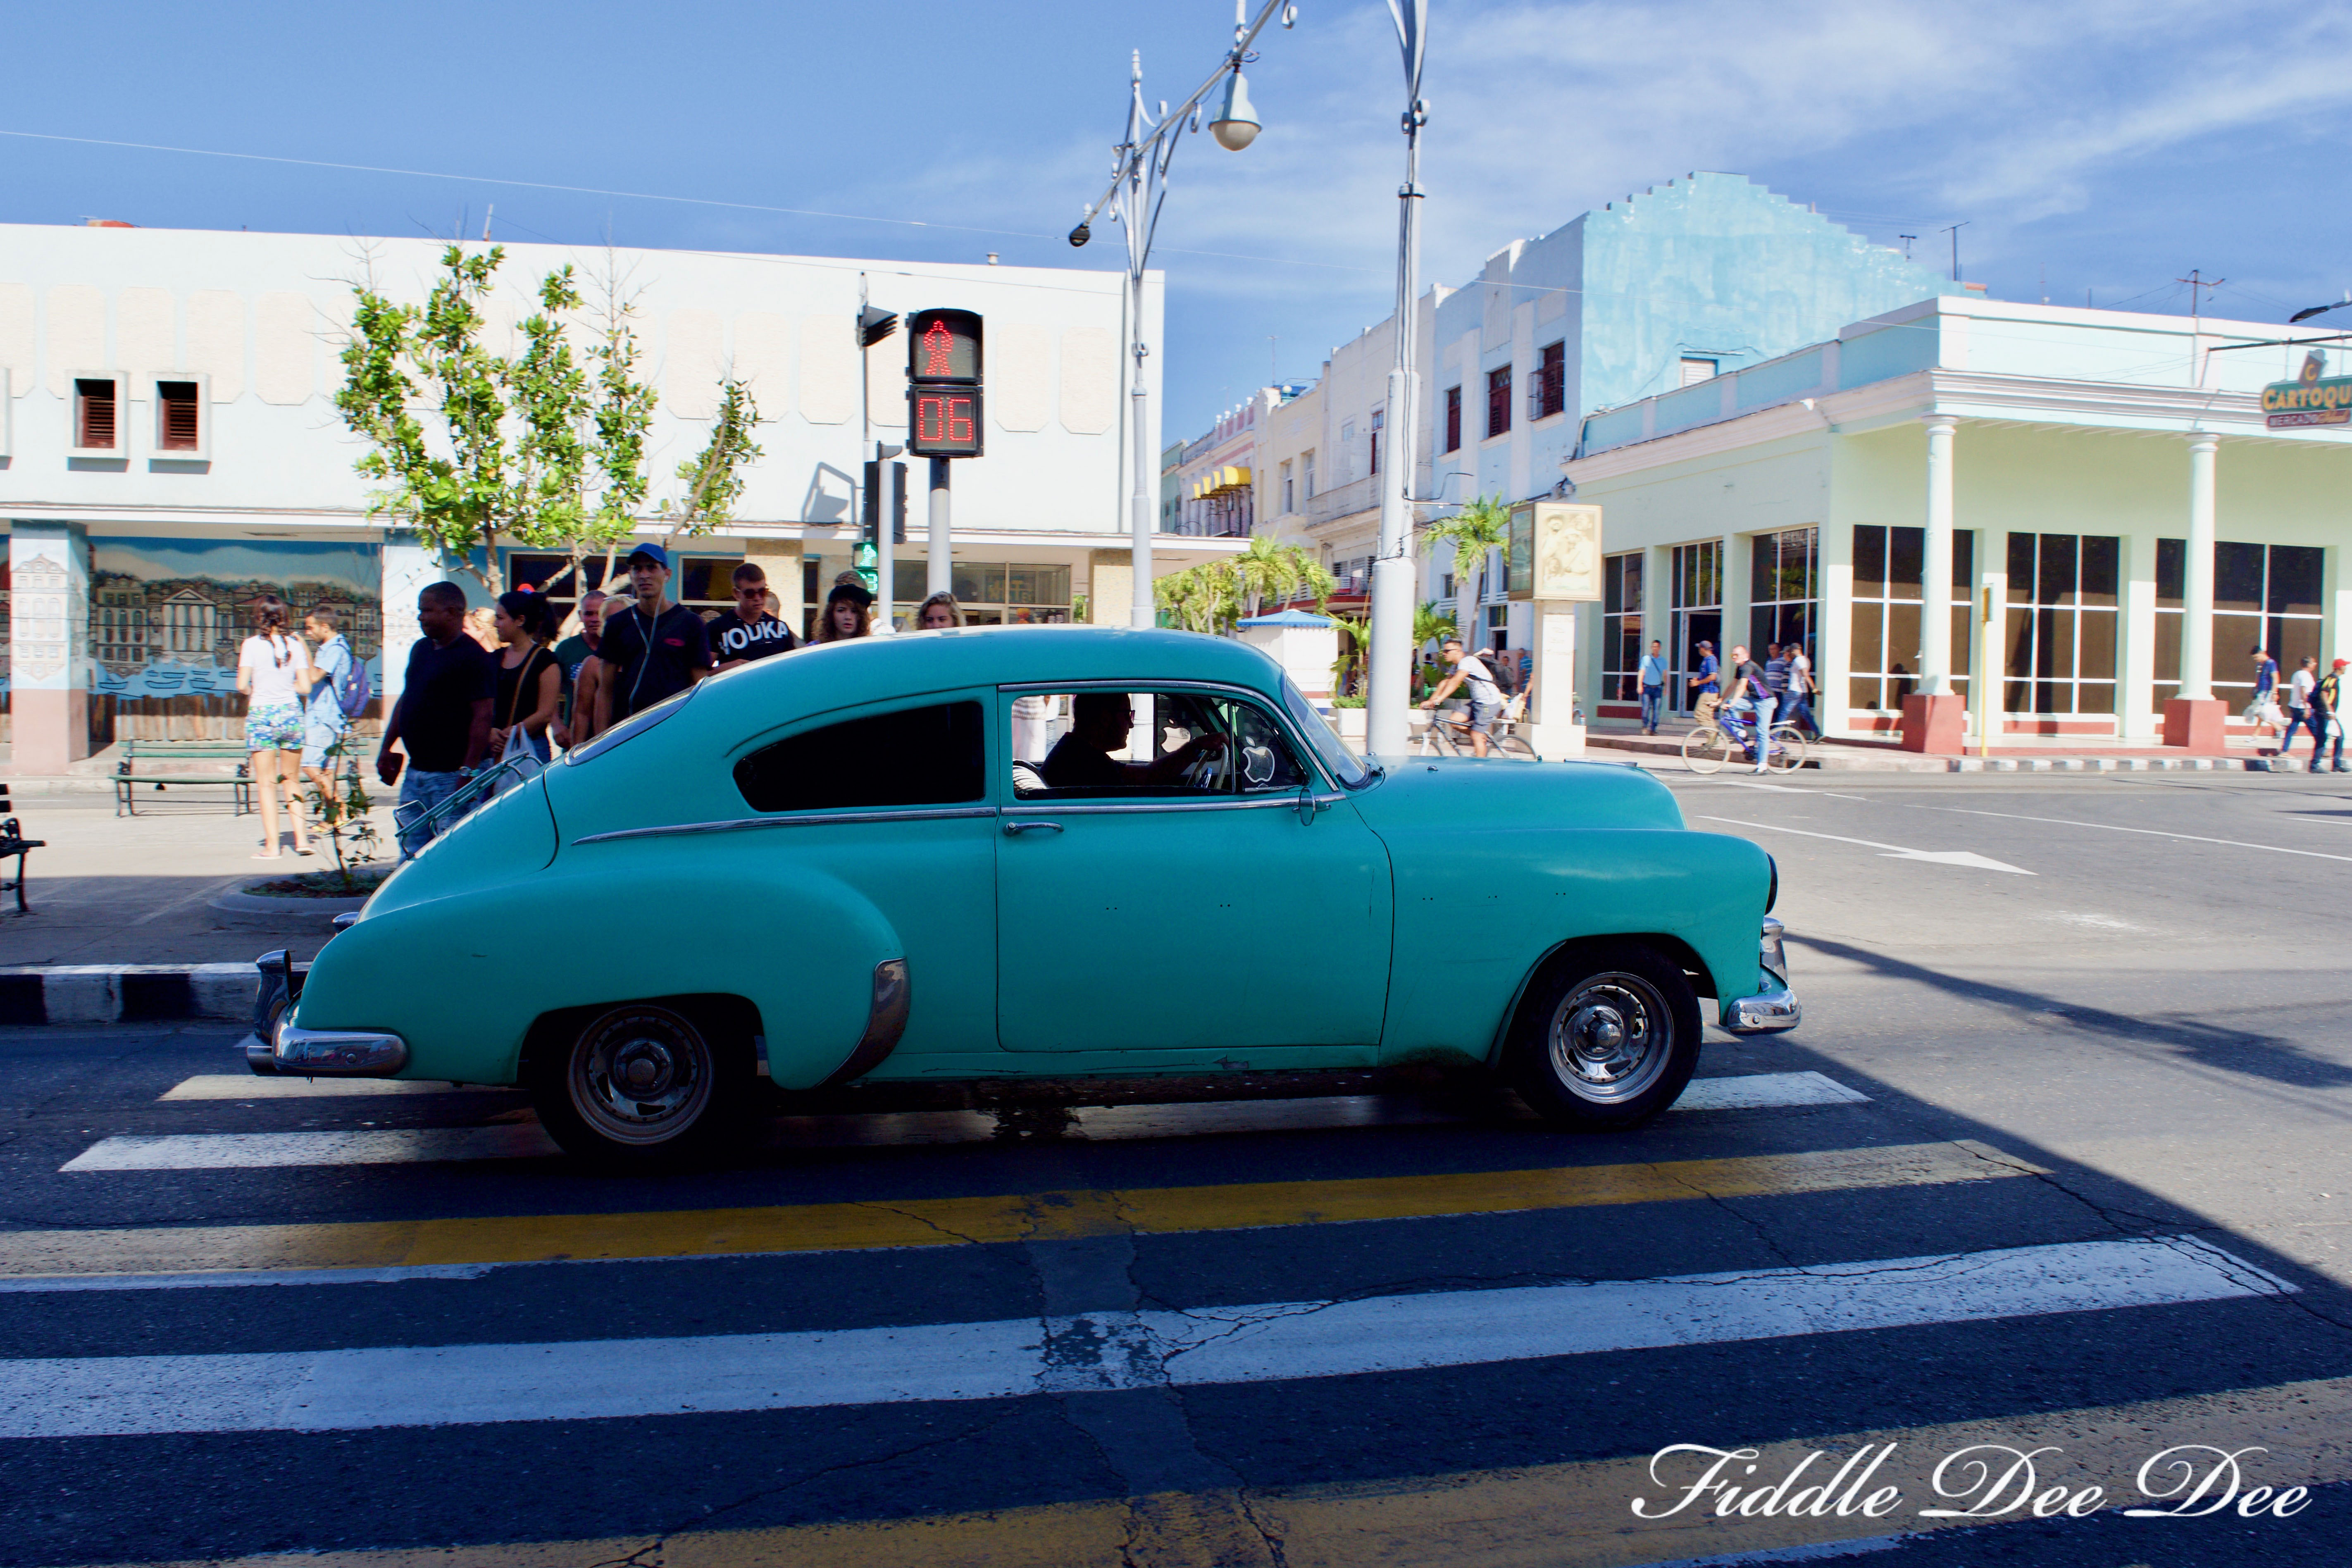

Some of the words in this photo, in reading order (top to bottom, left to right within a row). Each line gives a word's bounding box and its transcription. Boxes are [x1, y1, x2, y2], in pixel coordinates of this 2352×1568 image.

[2304, 364, 2317, 381] C
[2263, 385, 2352, 410] CARTOQU
[919, 398, 972, 441] 06
[860, 574, 878, 591] 3
